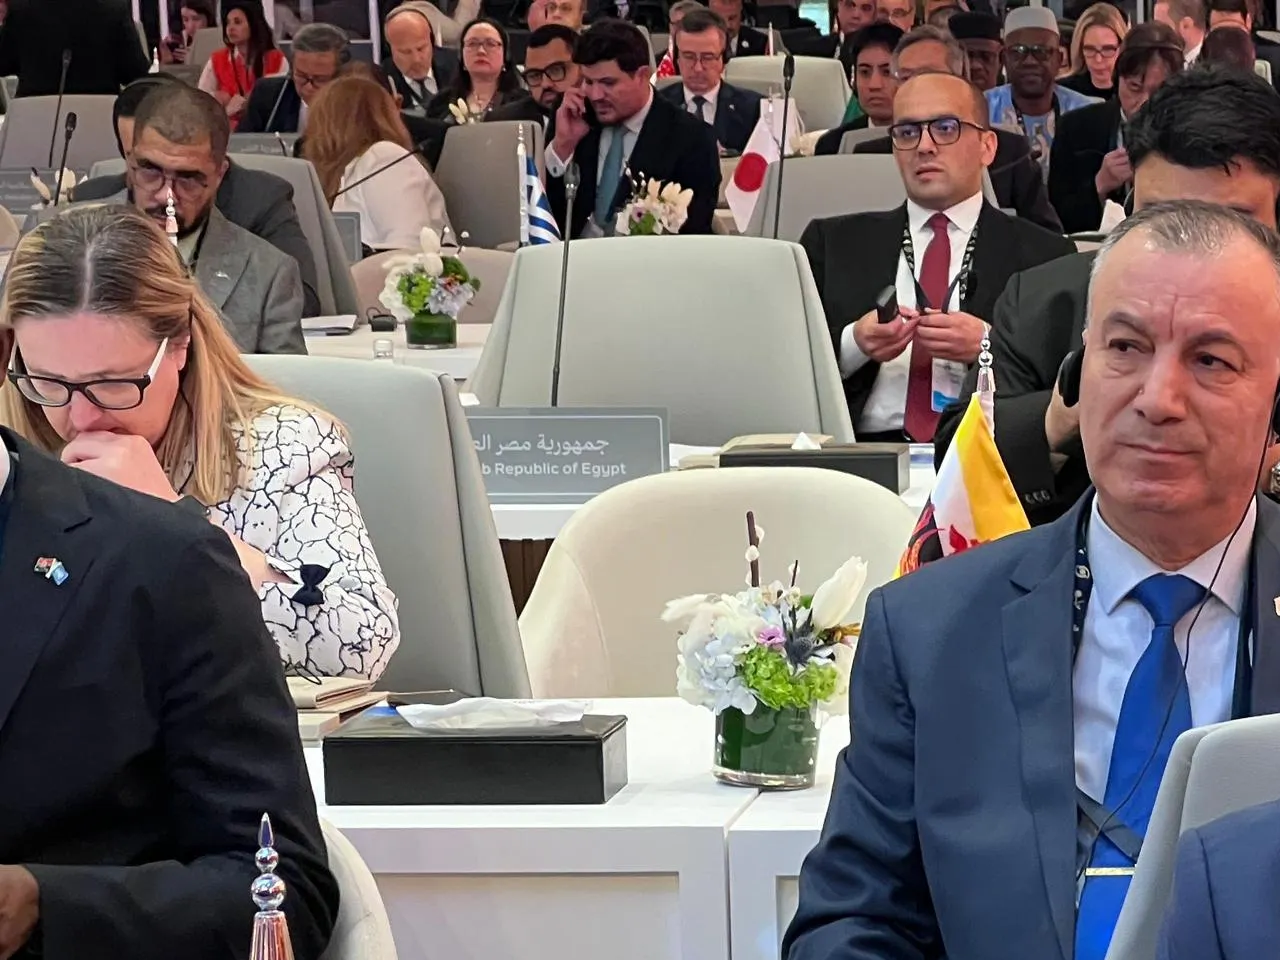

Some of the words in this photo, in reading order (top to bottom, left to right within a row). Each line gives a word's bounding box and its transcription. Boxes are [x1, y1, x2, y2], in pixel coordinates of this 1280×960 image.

[495, 440, 532, 456] مصر
[537, 433, 609, 455] جمهورية
[494, 462, 559, 477] Republic
[562, 462, 578, 475] of
[581, 462, 627, 478] Egypt
